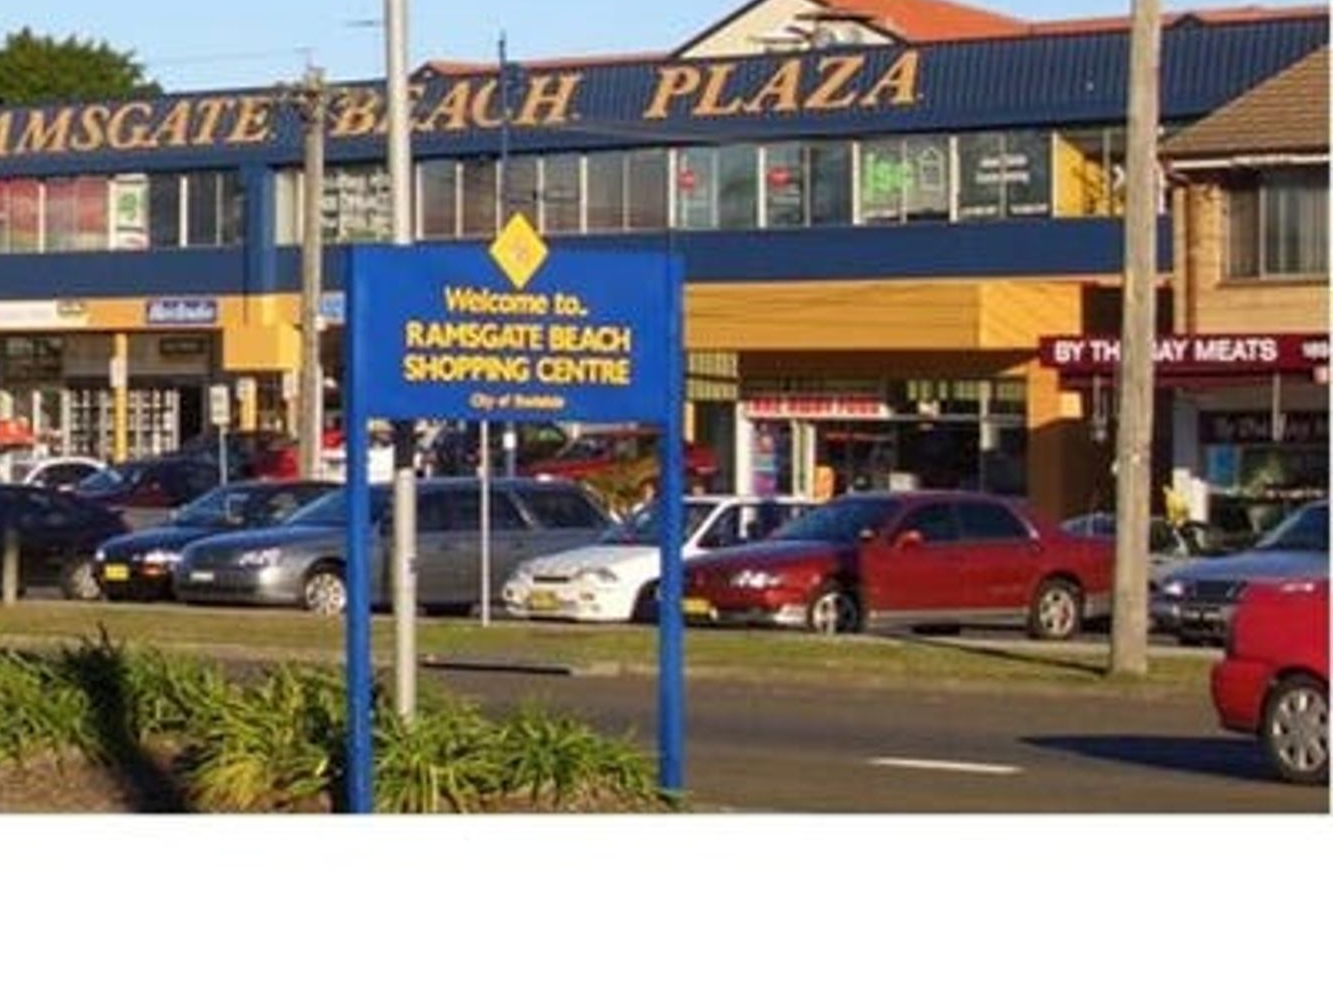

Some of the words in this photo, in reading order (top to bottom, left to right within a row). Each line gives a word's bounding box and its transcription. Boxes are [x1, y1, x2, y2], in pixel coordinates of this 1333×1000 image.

[644, 50, 923, 120] PLAZA
[445, 286, 548, 315] Welcome
[405, 321, 544, 350] RAMSGATE
[549, 325, 631, 352] BEACH
[1055, 340, 1084, 361] BY
[1090, 340, 1121, 361] TH
[1195, 339, 1278, 362] MEATS
[403, 354, 531, 382] SHOPPING
[536, 357, 631, 385] CENTRE
